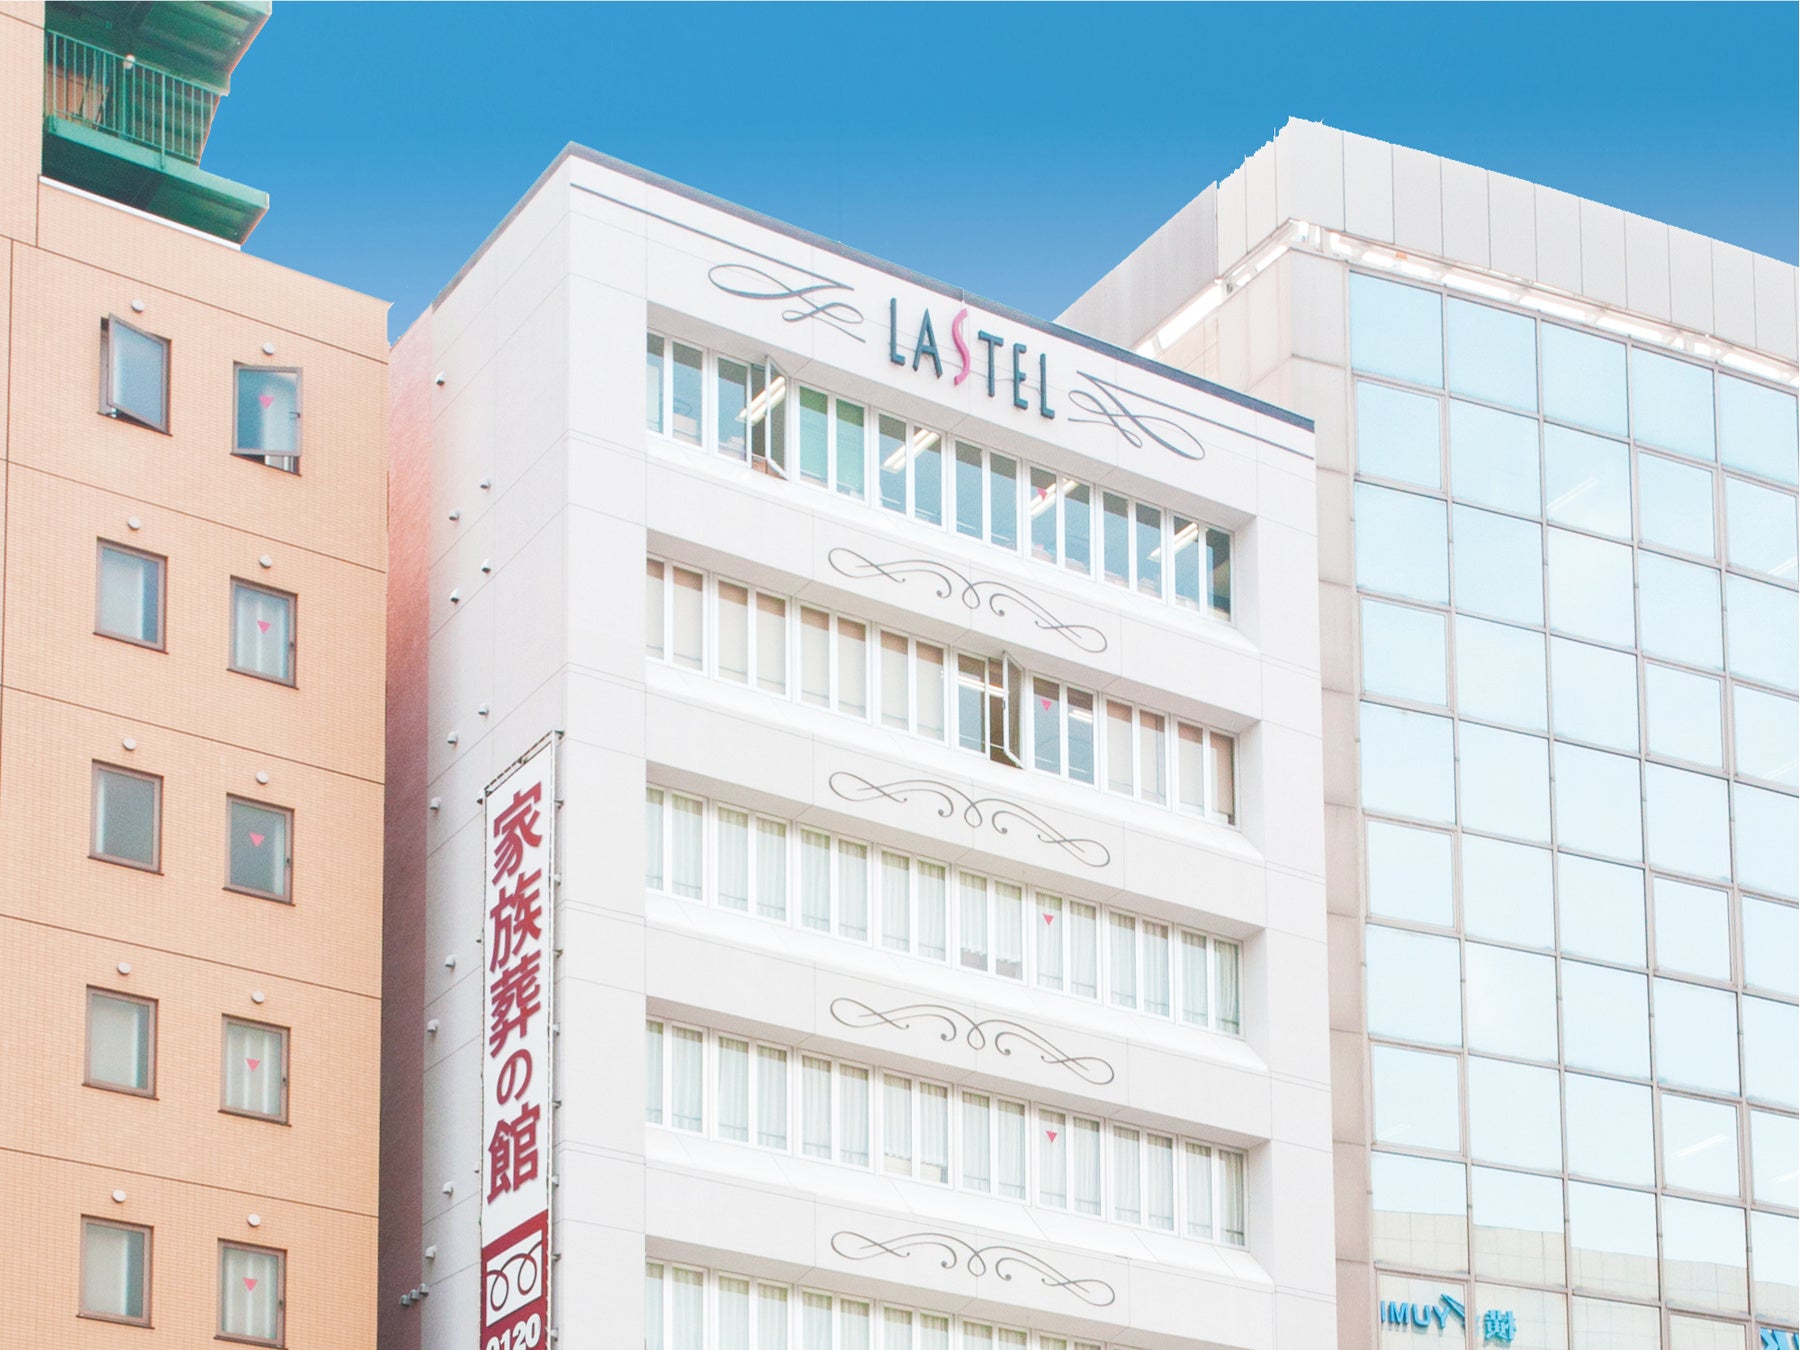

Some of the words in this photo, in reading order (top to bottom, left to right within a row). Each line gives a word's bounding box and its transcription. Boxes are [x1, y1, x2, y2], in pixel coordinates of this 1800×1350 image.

[890, 297, 1055, 420] LASTEL
[488, 780, 543, 1206] 家族葬の館
